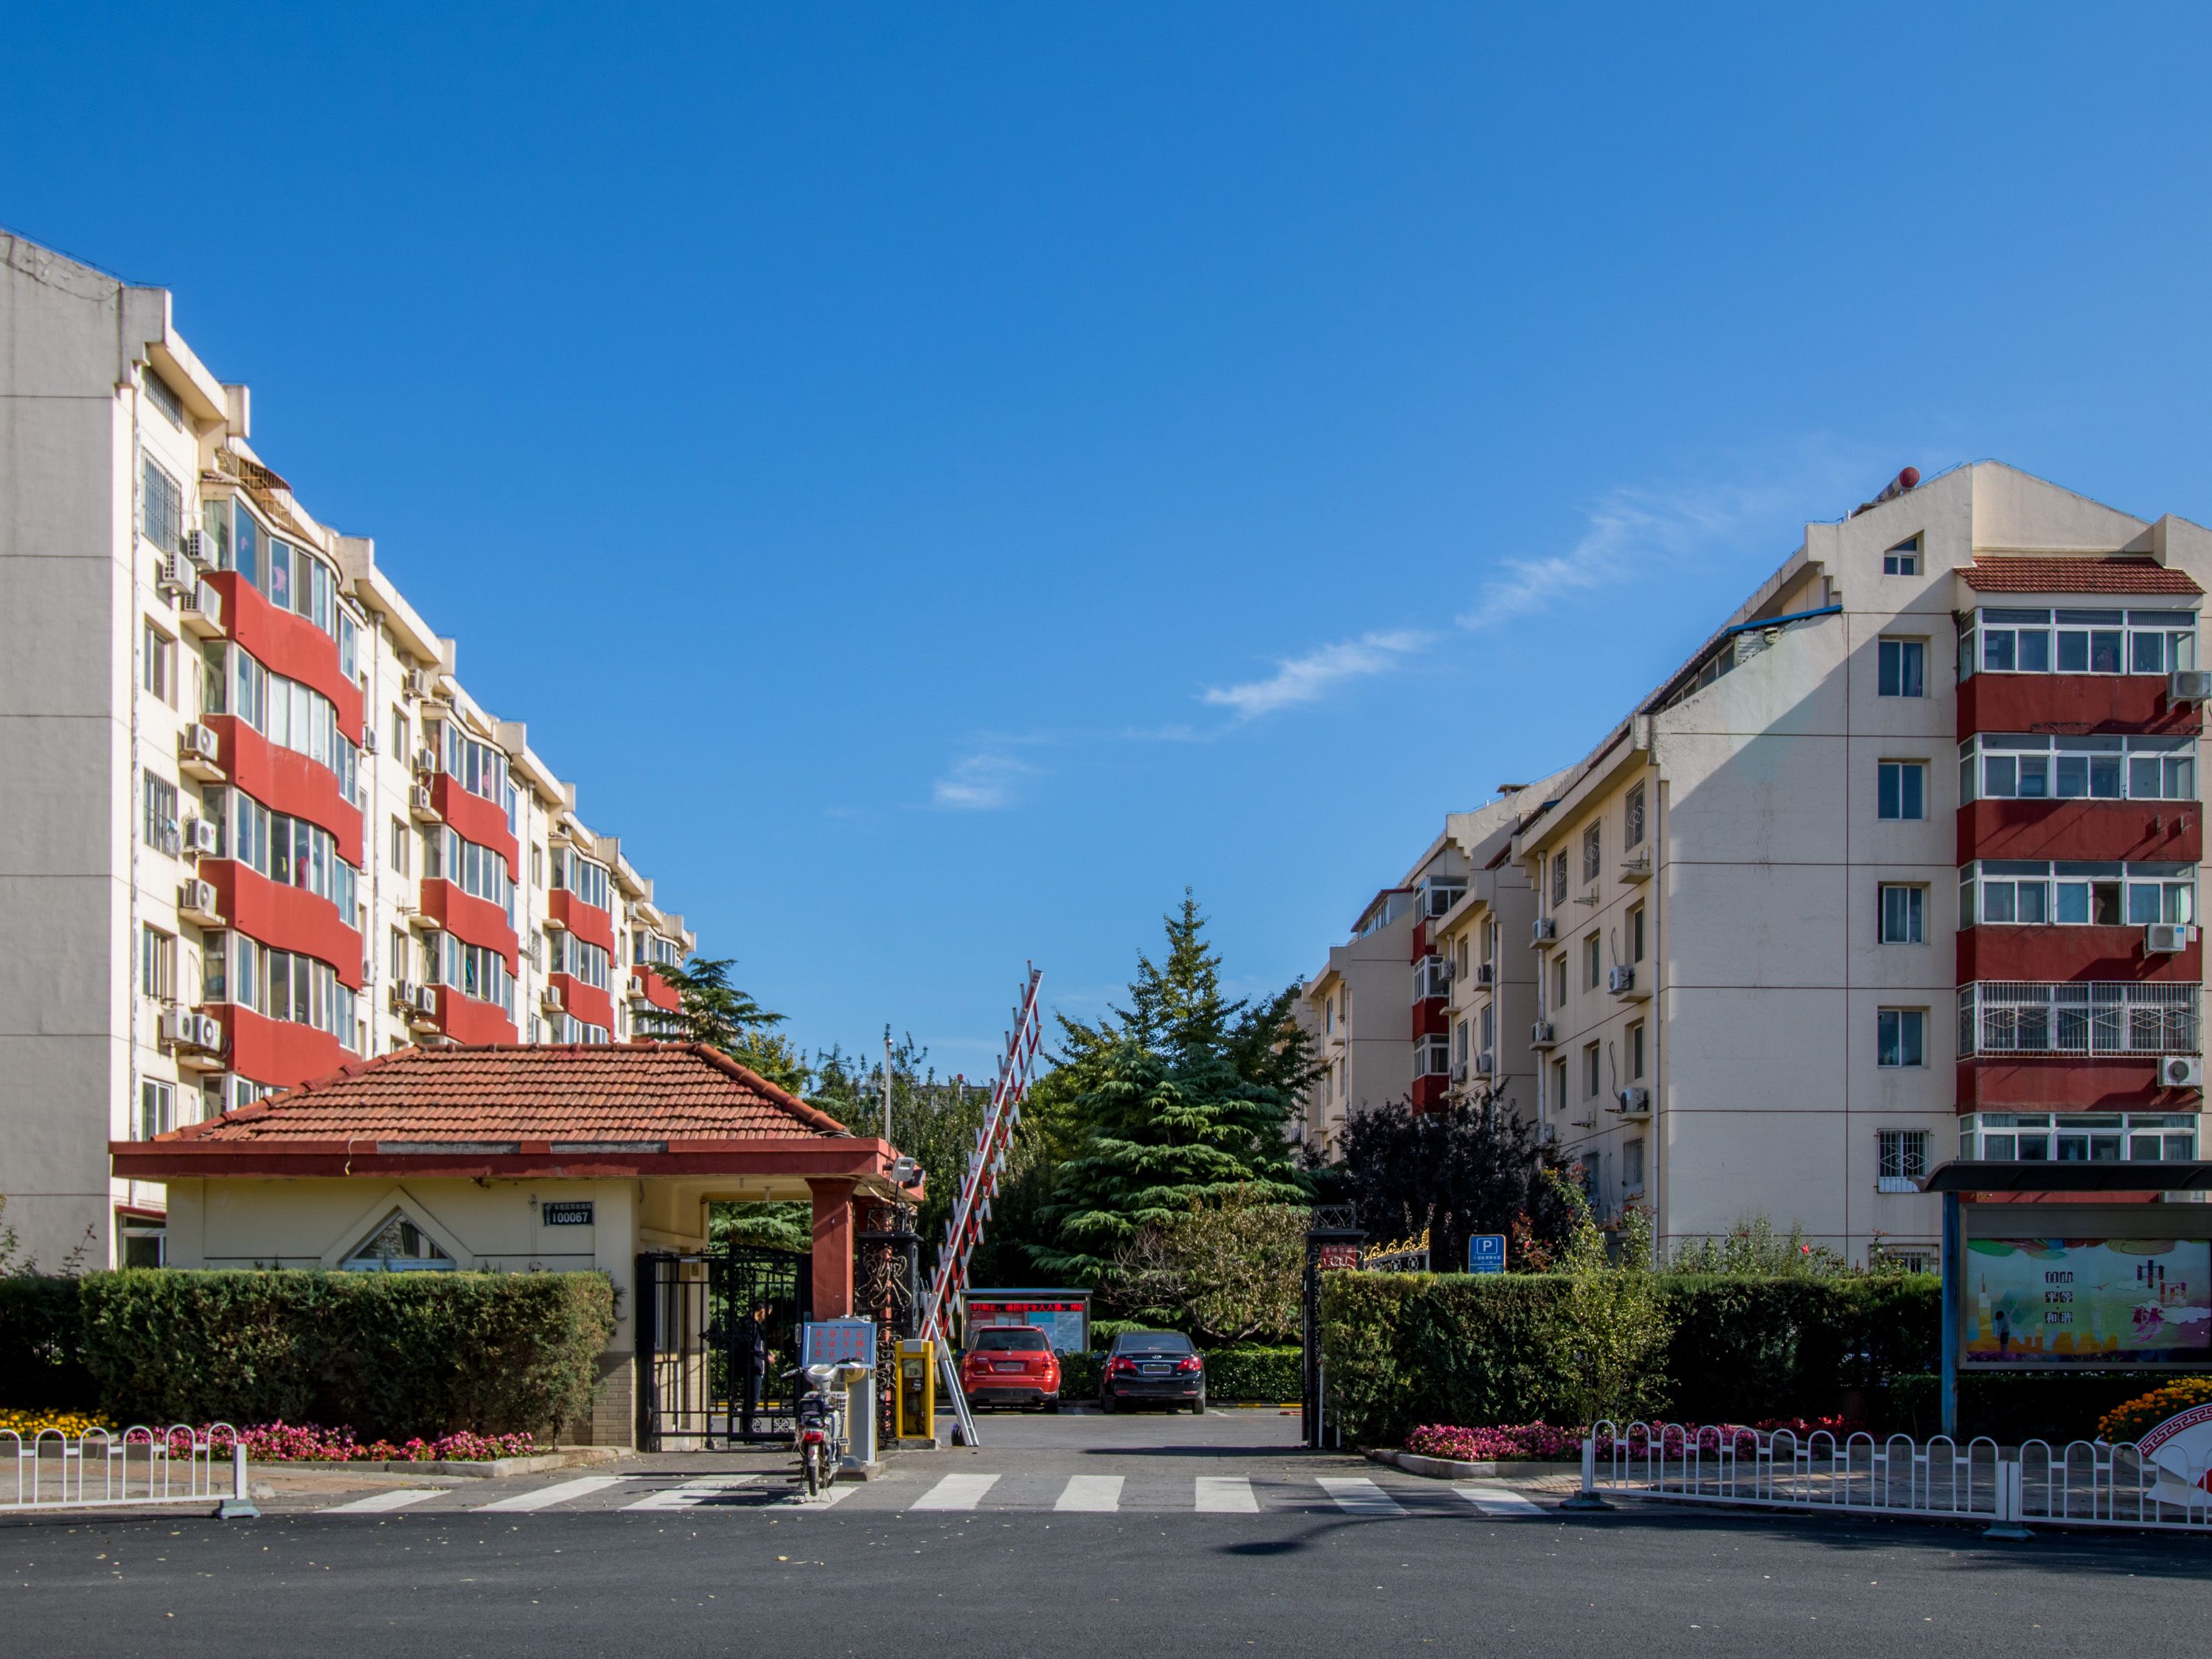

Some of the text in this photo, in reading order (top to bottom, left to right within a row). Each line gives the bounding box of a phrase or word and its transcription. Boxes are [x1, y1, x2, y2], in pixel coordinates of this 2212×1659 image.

[552, 1211, 588, 1223] 100067
[1483, 1239, 1492, 1252] P
[2045, 1292, 2073, 1303] 平等
[2132, 1259, 2187, 1343] 中国梦
[2045, 1312, 2073, 1324] 和谐
[815, 1329, 864, 1338] 来客登记
[815, 1340, 865, 1348] 无证车辆
[814, 1349, 864, 1357] 禁止入内
